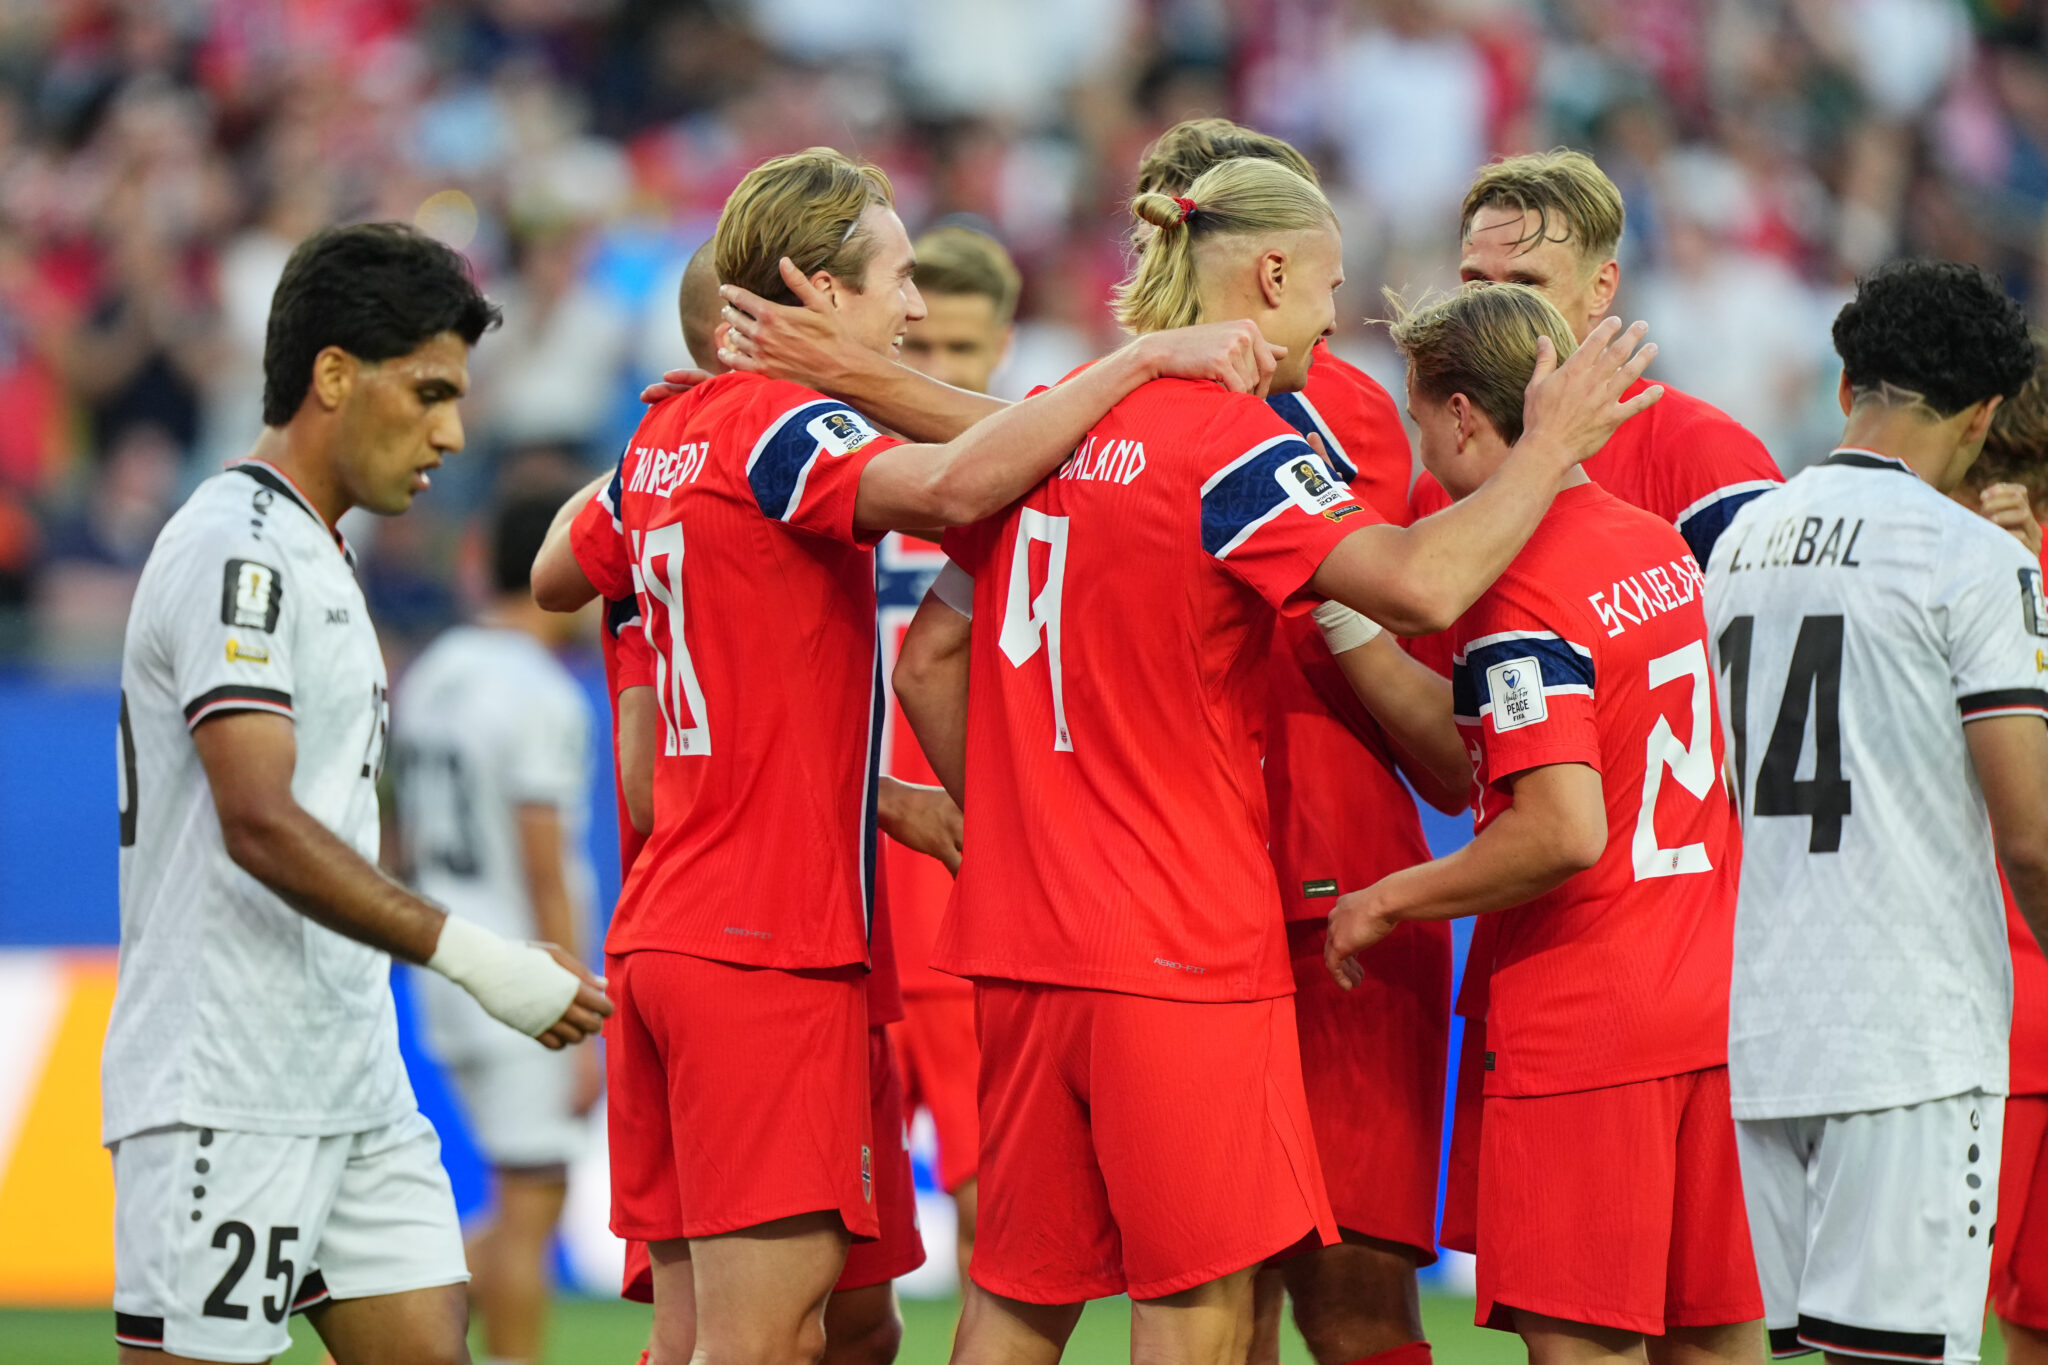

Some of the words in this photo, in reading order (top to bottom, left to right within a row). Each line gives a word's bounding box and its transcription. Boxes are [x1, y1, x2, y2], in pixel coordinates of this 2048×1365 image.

[1315, 483, 1329, 493] FIFA
[998, 506, 1074, 752] 9
[1587, 554, 1706, 639] SCHJELDE
[1507, 699, 1530, 716] PEACE
[1513, 713, 1525, 722] FIFA
[1717, 614, 1852, 853] 14
[1632, 638, 1730, 882] 2
[202, 1220, 299, 1324] 25
